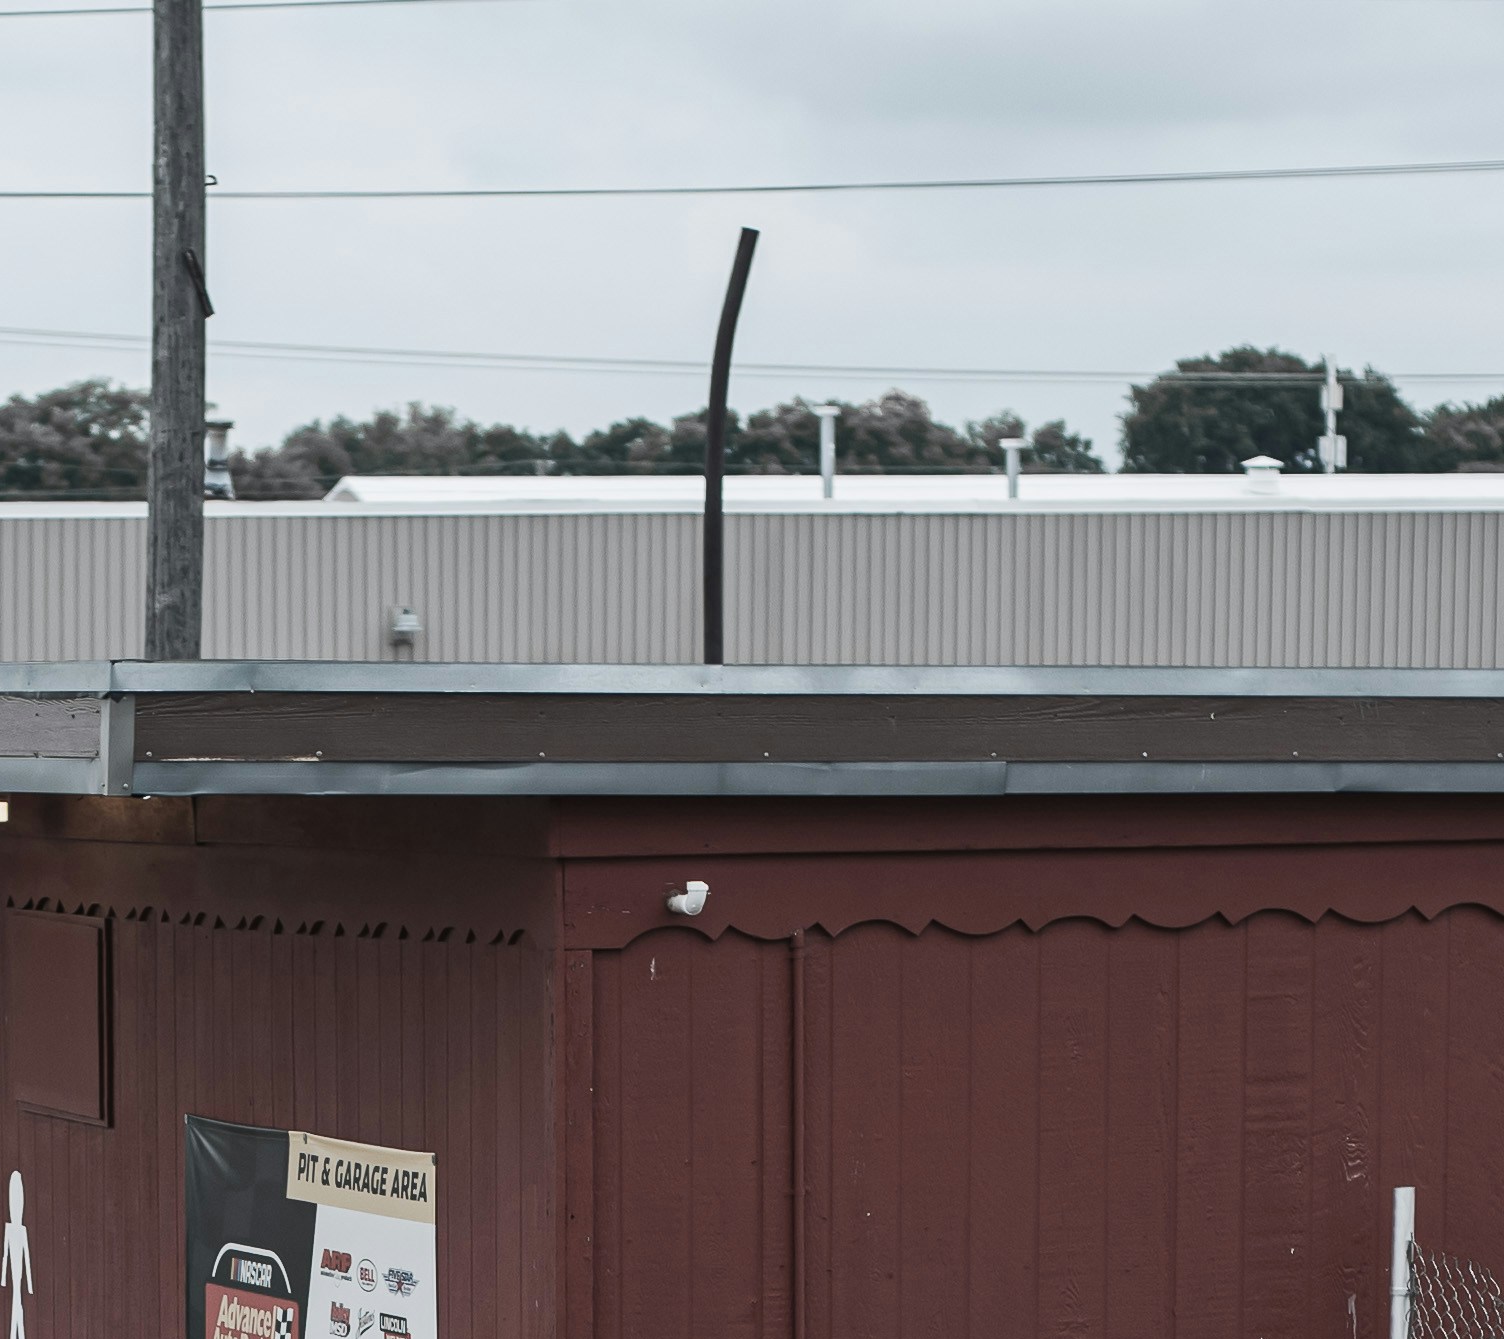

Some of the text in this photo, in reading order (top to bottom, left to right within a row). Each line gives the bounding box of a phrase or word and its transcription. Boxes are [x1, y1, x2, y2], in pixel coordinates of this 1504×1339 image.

[297, 1152, 428, 1203] PIT & GARAGE AREA
[239, 1260, 273, 1289] NASCAR
[320, 1248, 352, 1274] ARP
[359, 1267, 375, 1283] BELL
[216, 1294, 272, 1338] Advance
[381, 1316, 406, 1334] LINCOLN
